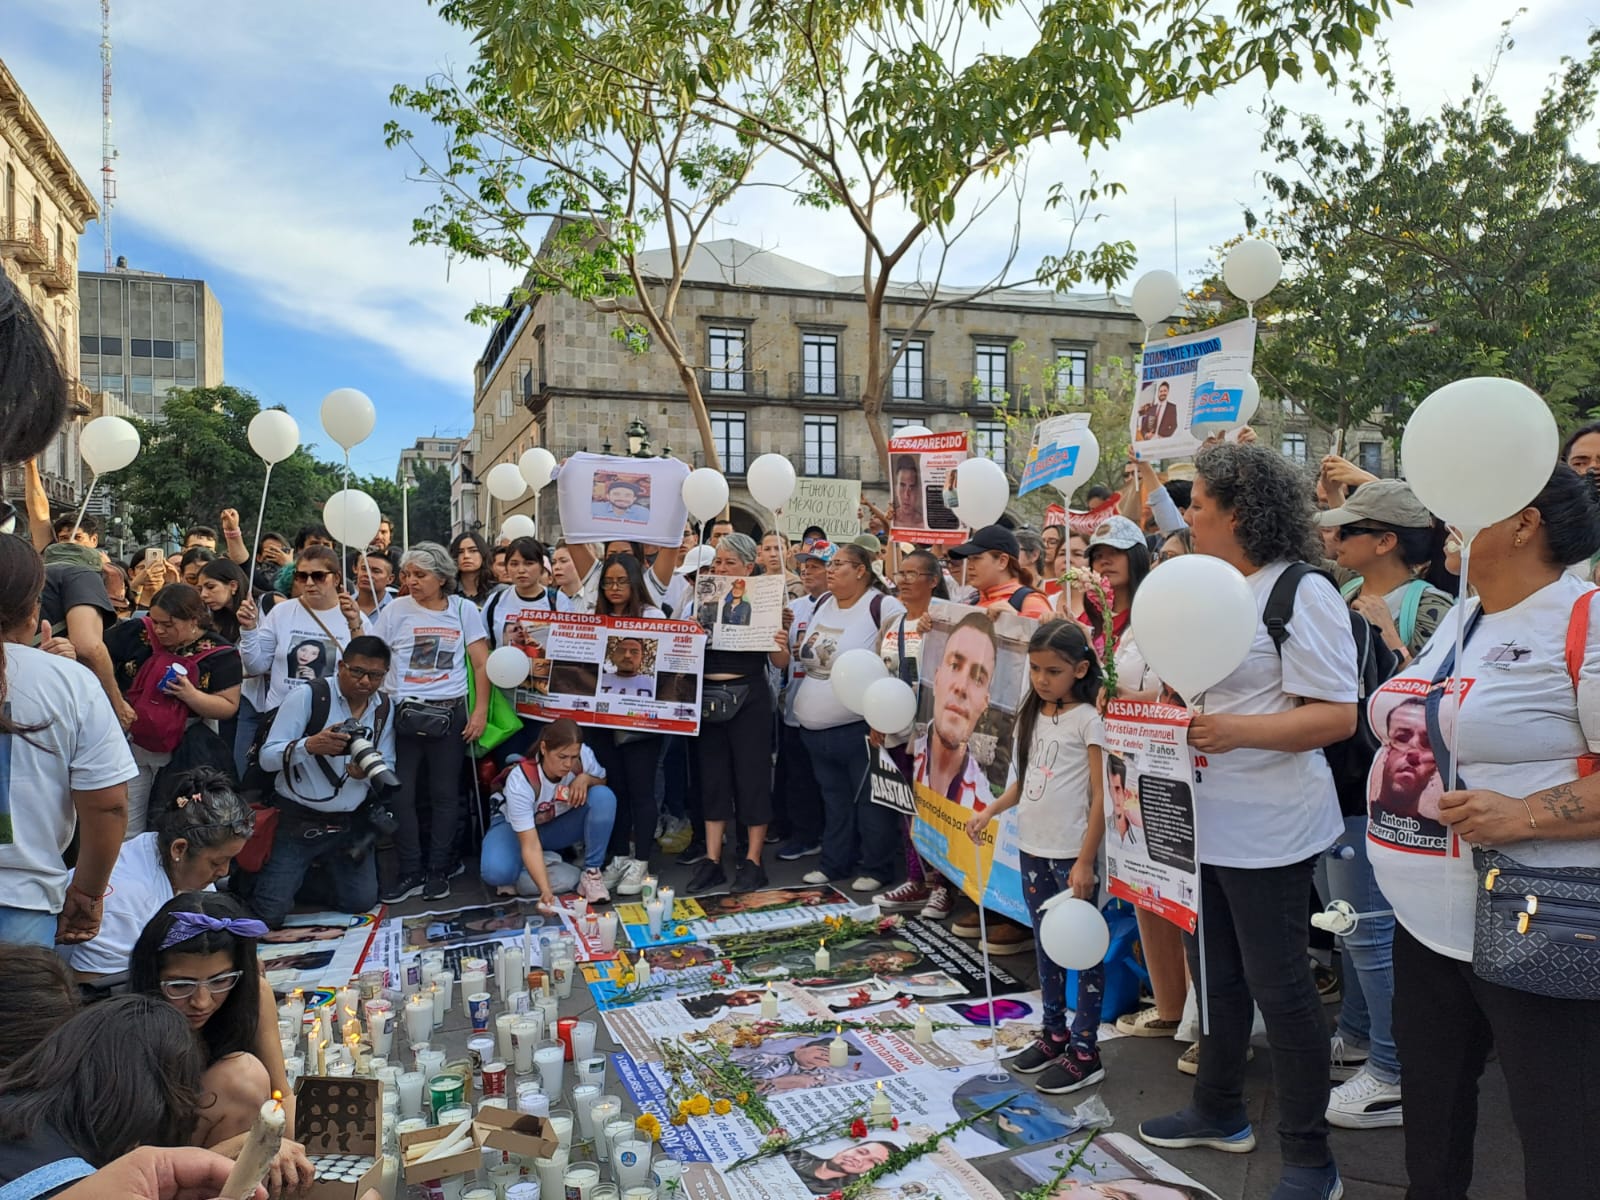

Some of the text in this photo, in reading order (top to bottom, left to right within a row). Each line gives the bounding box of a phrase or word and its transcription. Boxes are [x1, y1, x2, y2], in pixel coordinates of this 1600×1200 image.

[1193, 338, 1220, 356] AYUDA
[891, 435, 962, 449] DESAPARECIDO
[615, 620, 698, 633] DESAPARECIDO
[1107, 702, 1189, 720] DESAPARECIDO
[1139, 727, 1175, 740] Emmanuel
[1156, 745, 1175, 756] años
[1381, 812, 1420, 831] Antonio
[1397, 830, 1448, 848] Olivares
[722, 1132, 744, 1152] Enero
